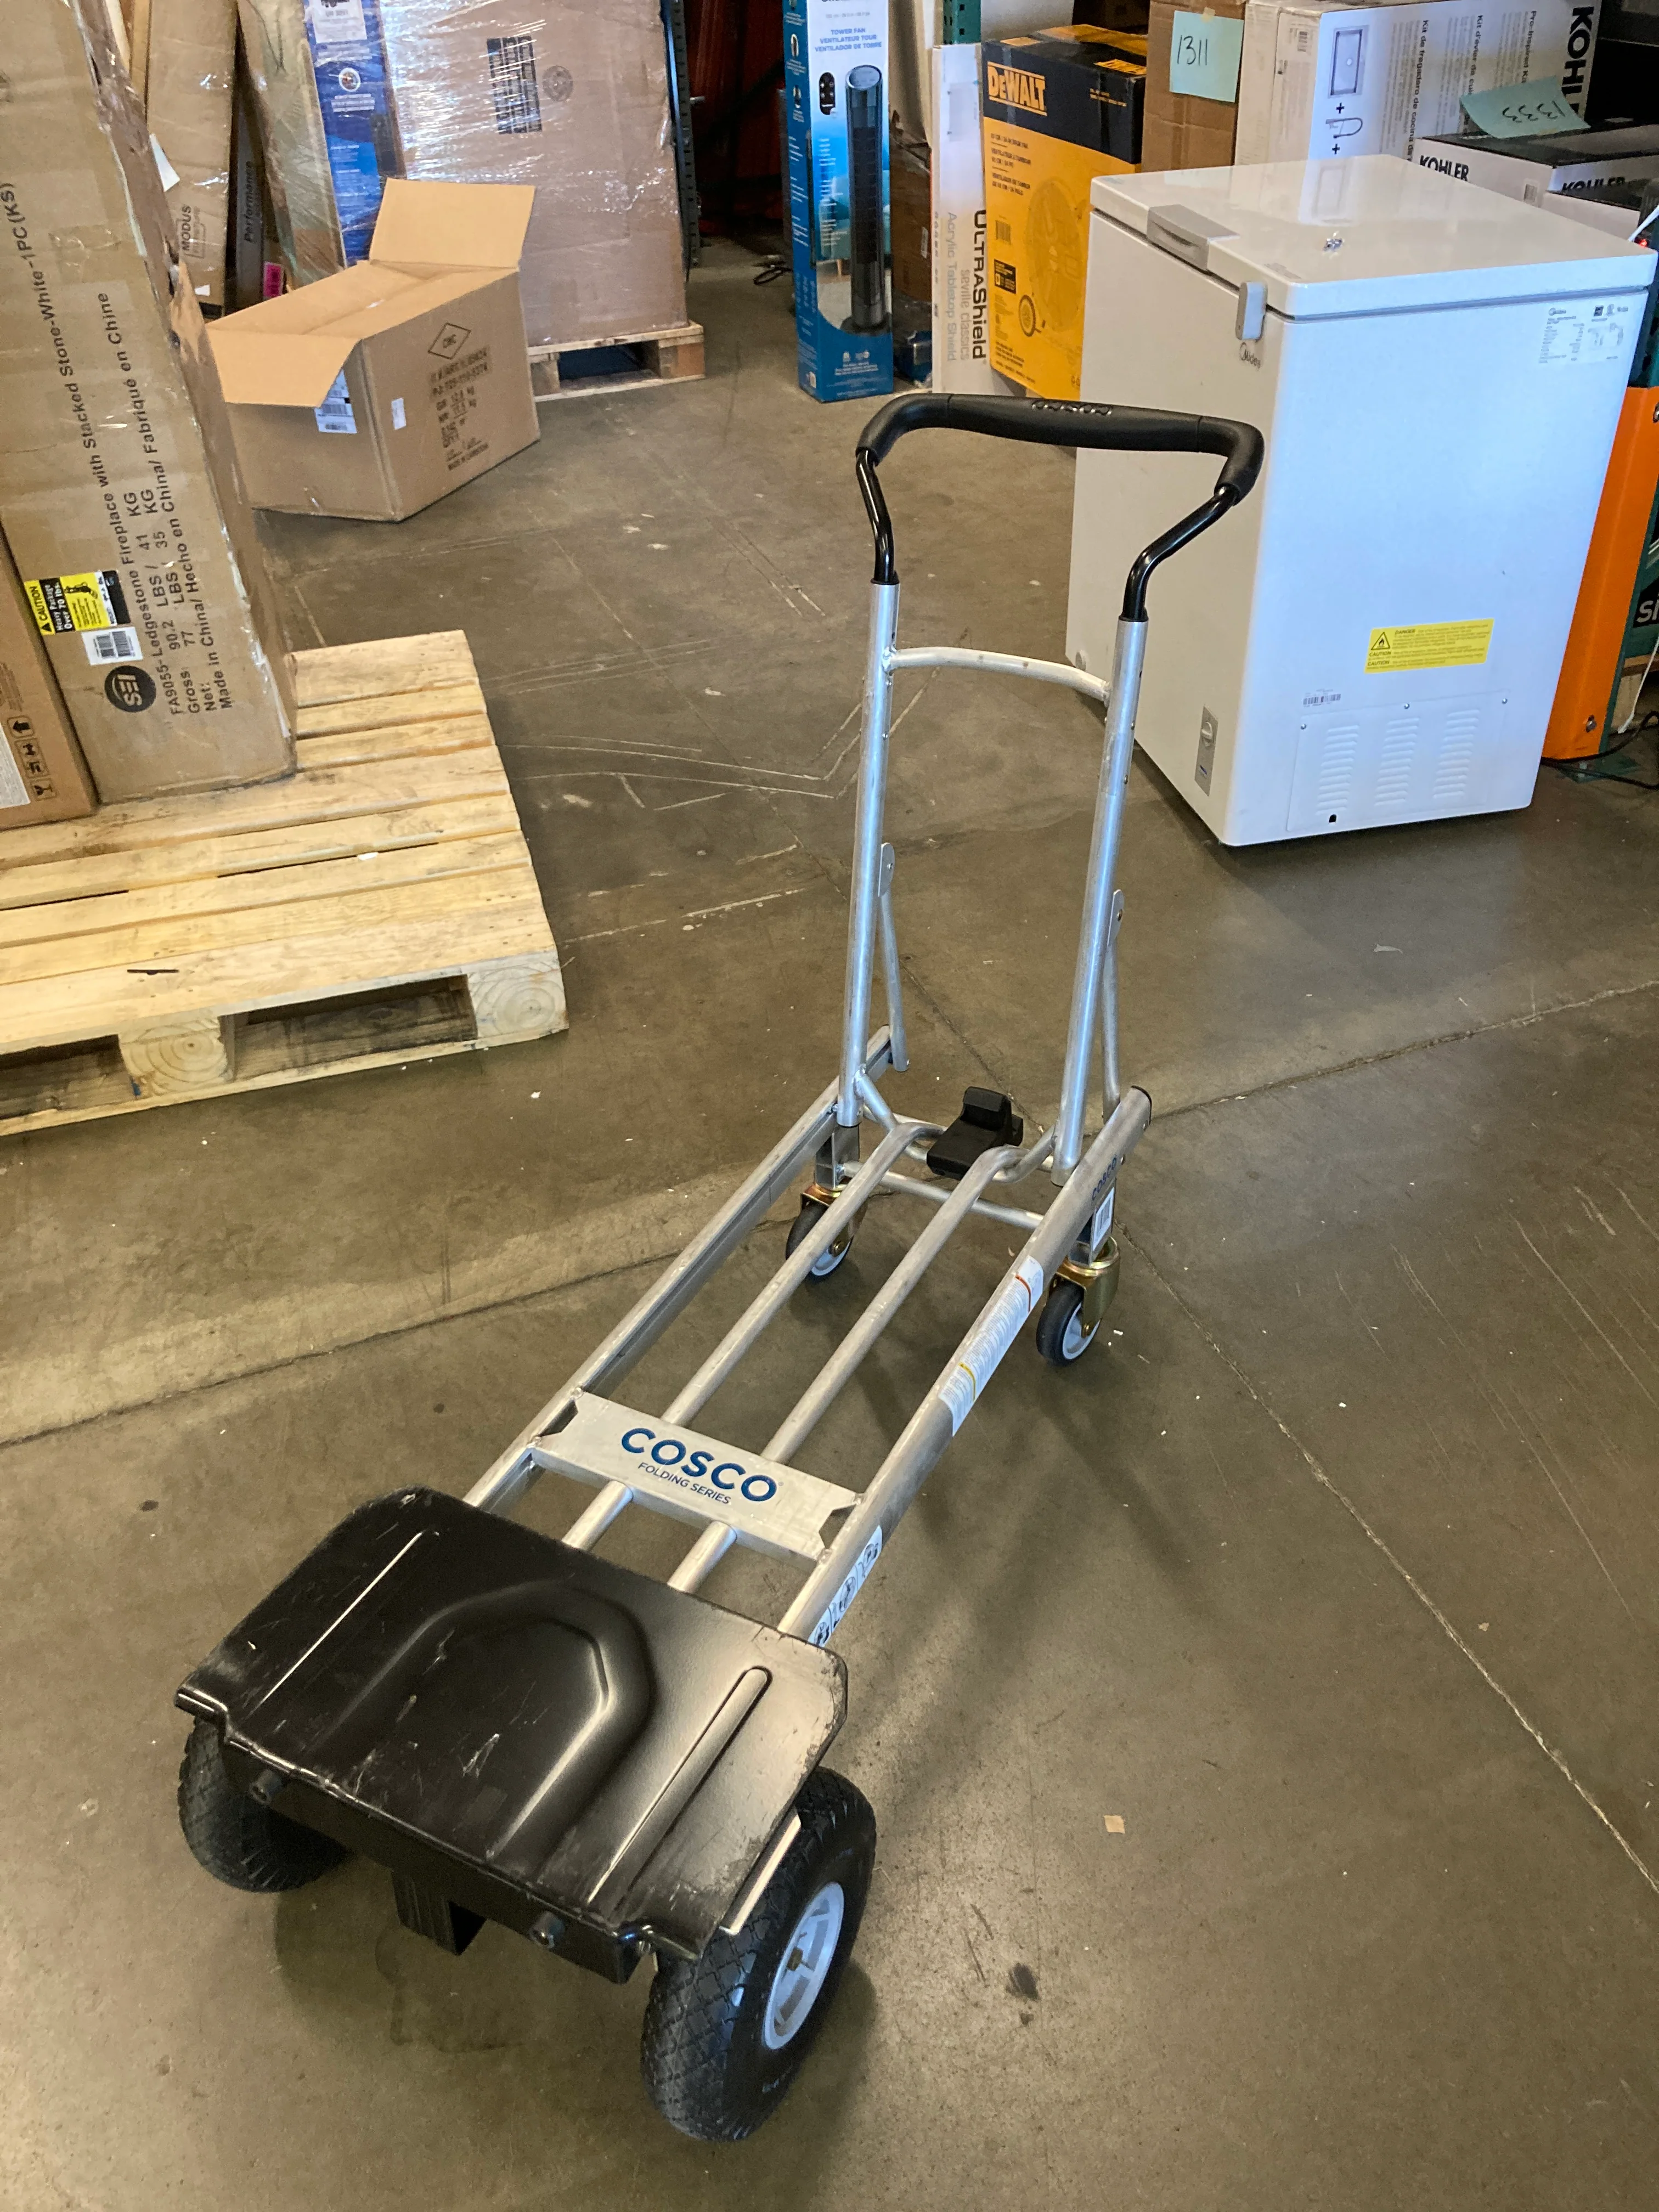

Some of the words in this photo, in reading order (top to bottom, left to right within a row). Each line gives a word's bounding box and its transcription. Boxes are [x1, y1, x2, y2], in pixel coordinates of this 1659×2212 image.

[1177, 35, 1208, 66] 1311
[1420, 35, 1426, 48] de
[1412, 97, 1420, 110] de
[1502, 100, 1566, 123] 1333
[1408, 111, 1417, 142] cocina
[1419, 155, 1469, 182] KOHLER
[181, 205, 191, 251] MODUS
[945, 212, 957, 258] Acrylic
[945, 261, 957, 319] Tabletop
[961, 269, 971, 309] seville
[98, 292, 122, 345] Chine
[947, 322, 957, 362] Shield
[960, 311, 970, 361] classics
[116, 351, 131, 371] en
[65, 382, 96, 449] Stacked
[123, 379, 157, 454] Fabriqué
[90, 454, 109, 488] with
[148, 460, 174, 512] China/
[124, 492, 142, 517] KG
[140, 489, 158, 514] KG
[104, 493, 134, 565] Fireplace
[136, 534, 150, 550] 41
[153, 531, 168, 548] 35
[169, 518, 183, 537] en
[177, 543, 199, 593] Hecho
[30, 585, 48, 622] CAUTION
[149, 575, 168, 607] LBS
[166, 572, 184, 603] LBS
[57, 599, 66, 610] 70
[62, 611, 72, 629] Over
[181, 631, 196, 646] 77
[189, 599, 213, 647] China/
[208, 652, 219, 666] in
[117, 674, 143, 707] SEI
[214, 670, 233, 709] Made
[1092, 1157, 1117, 1201] COSCO
[622, 1427, 777, 1502] COSCO
[637, 1462, 690, 1488] FOLDING
[690, 1483, 732, 1505] SERIES
